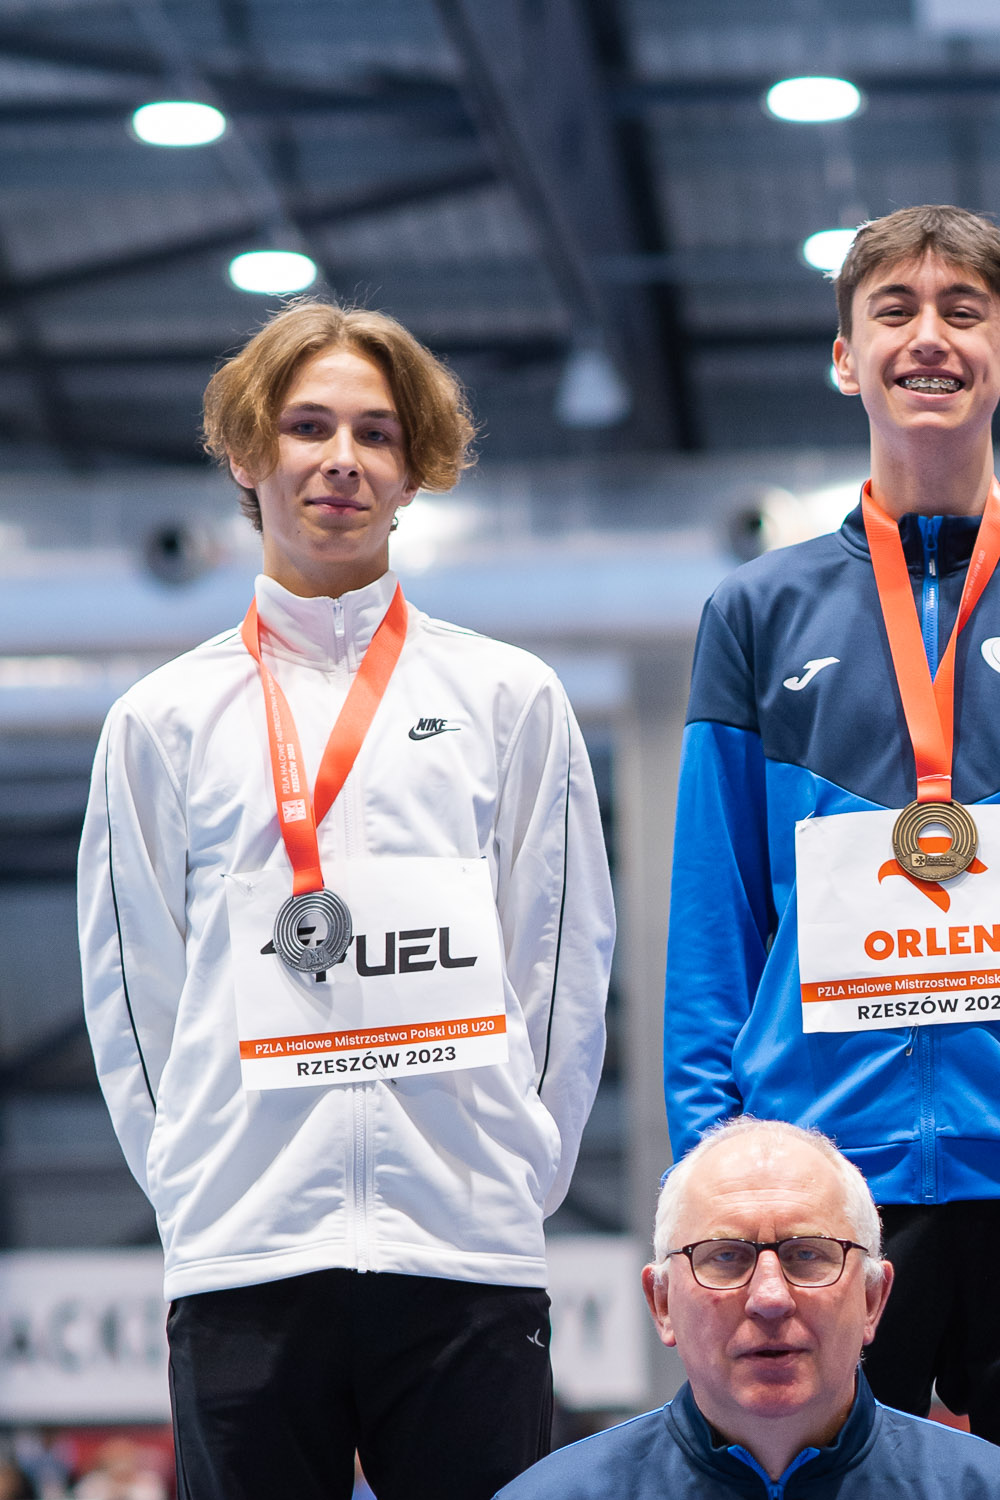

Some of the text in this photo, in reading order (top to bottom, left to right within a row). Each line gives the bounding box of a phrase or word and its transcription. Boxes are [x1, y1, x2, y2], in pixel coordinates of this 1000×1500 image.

[416, 718, 448, 731] NIKE
[277, 743, 287, 775] HALOWE
[261, 926, 477, 983] UEL
[817, 986, 845, 998] PZLA
[848, 982, 892, 996] Halowe
[895, 976, 967, 991] Mistrzostwa
[857, 995, 959, 1020] RZESZÓW
[255, 1020, 495, 1055] PZLA Halowe Mistrzostwa Polski U18 U20
[297, 1046, 457, 1077] RZESZÓW 2023
